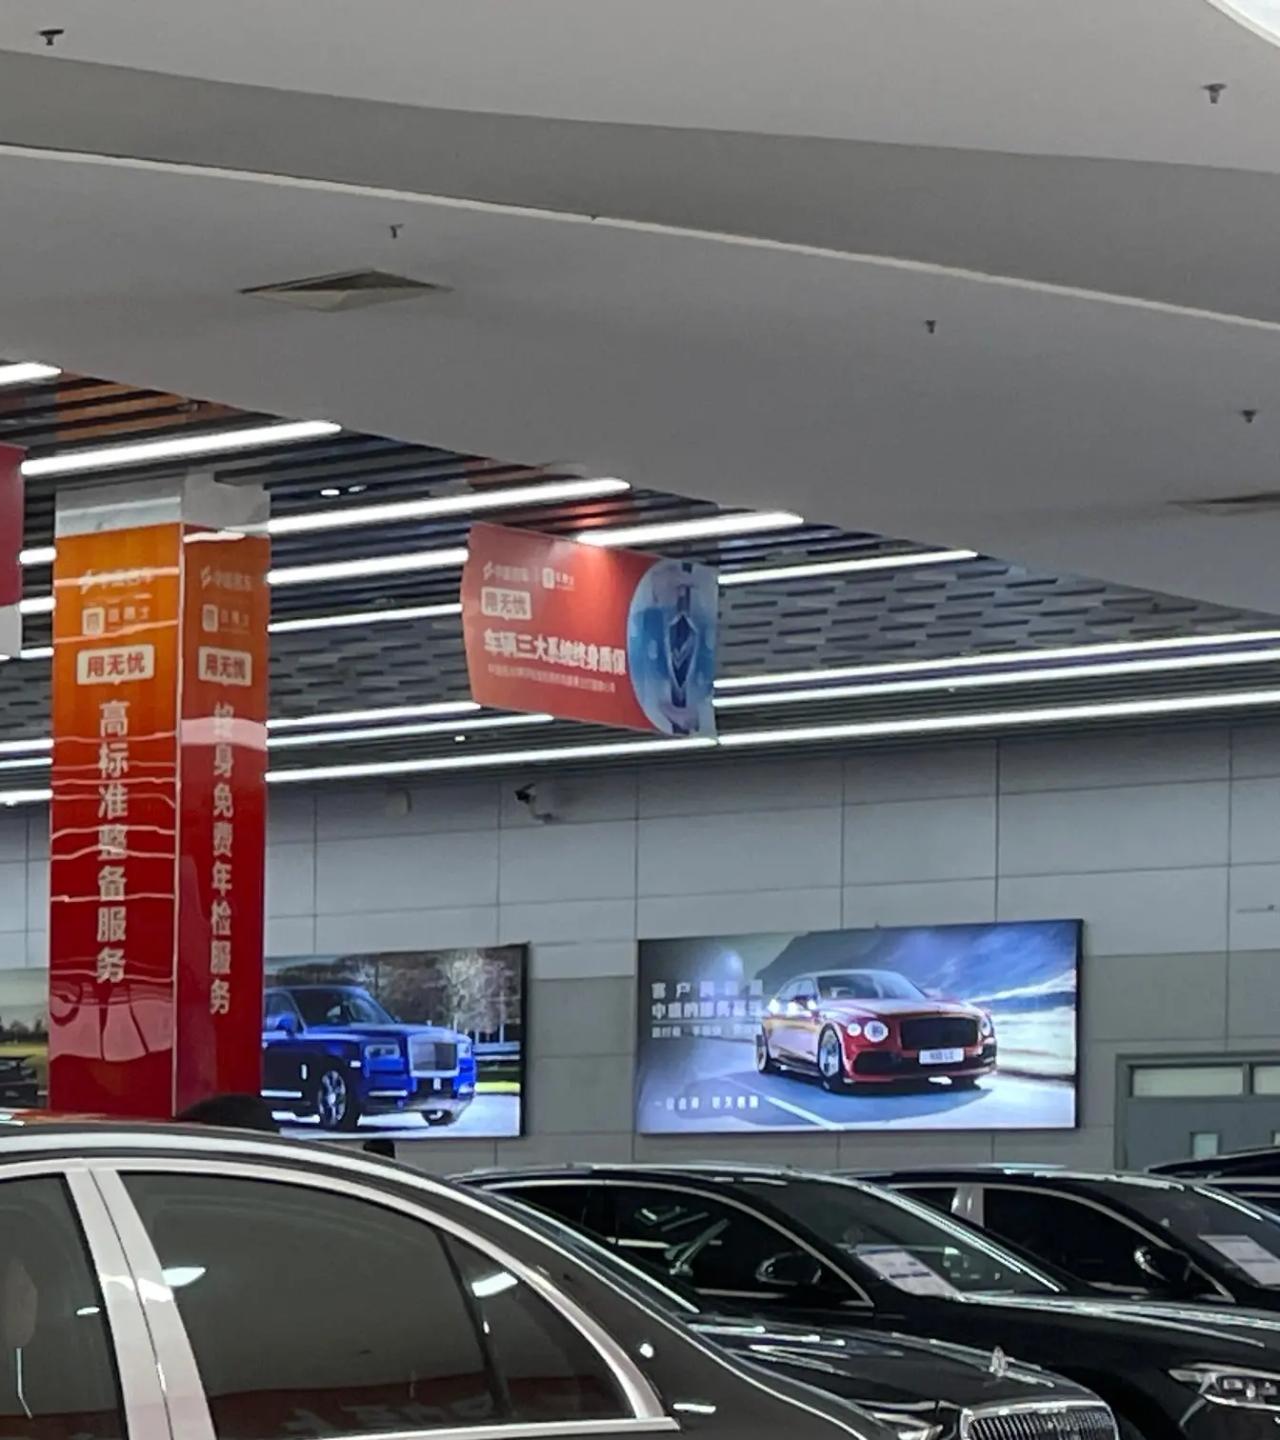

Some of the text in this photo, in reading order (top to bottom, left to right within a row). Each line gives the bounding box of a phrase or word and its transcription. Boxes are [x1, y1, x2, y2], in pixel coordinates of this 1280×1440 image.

[86, 652, 146, 679] 用无忧
[204, 652, 247, 681] 用无忧
[96, 700, 130, 985] 高标准整备服务
[209, 701, 235, 1016] 终身免费年检服务
